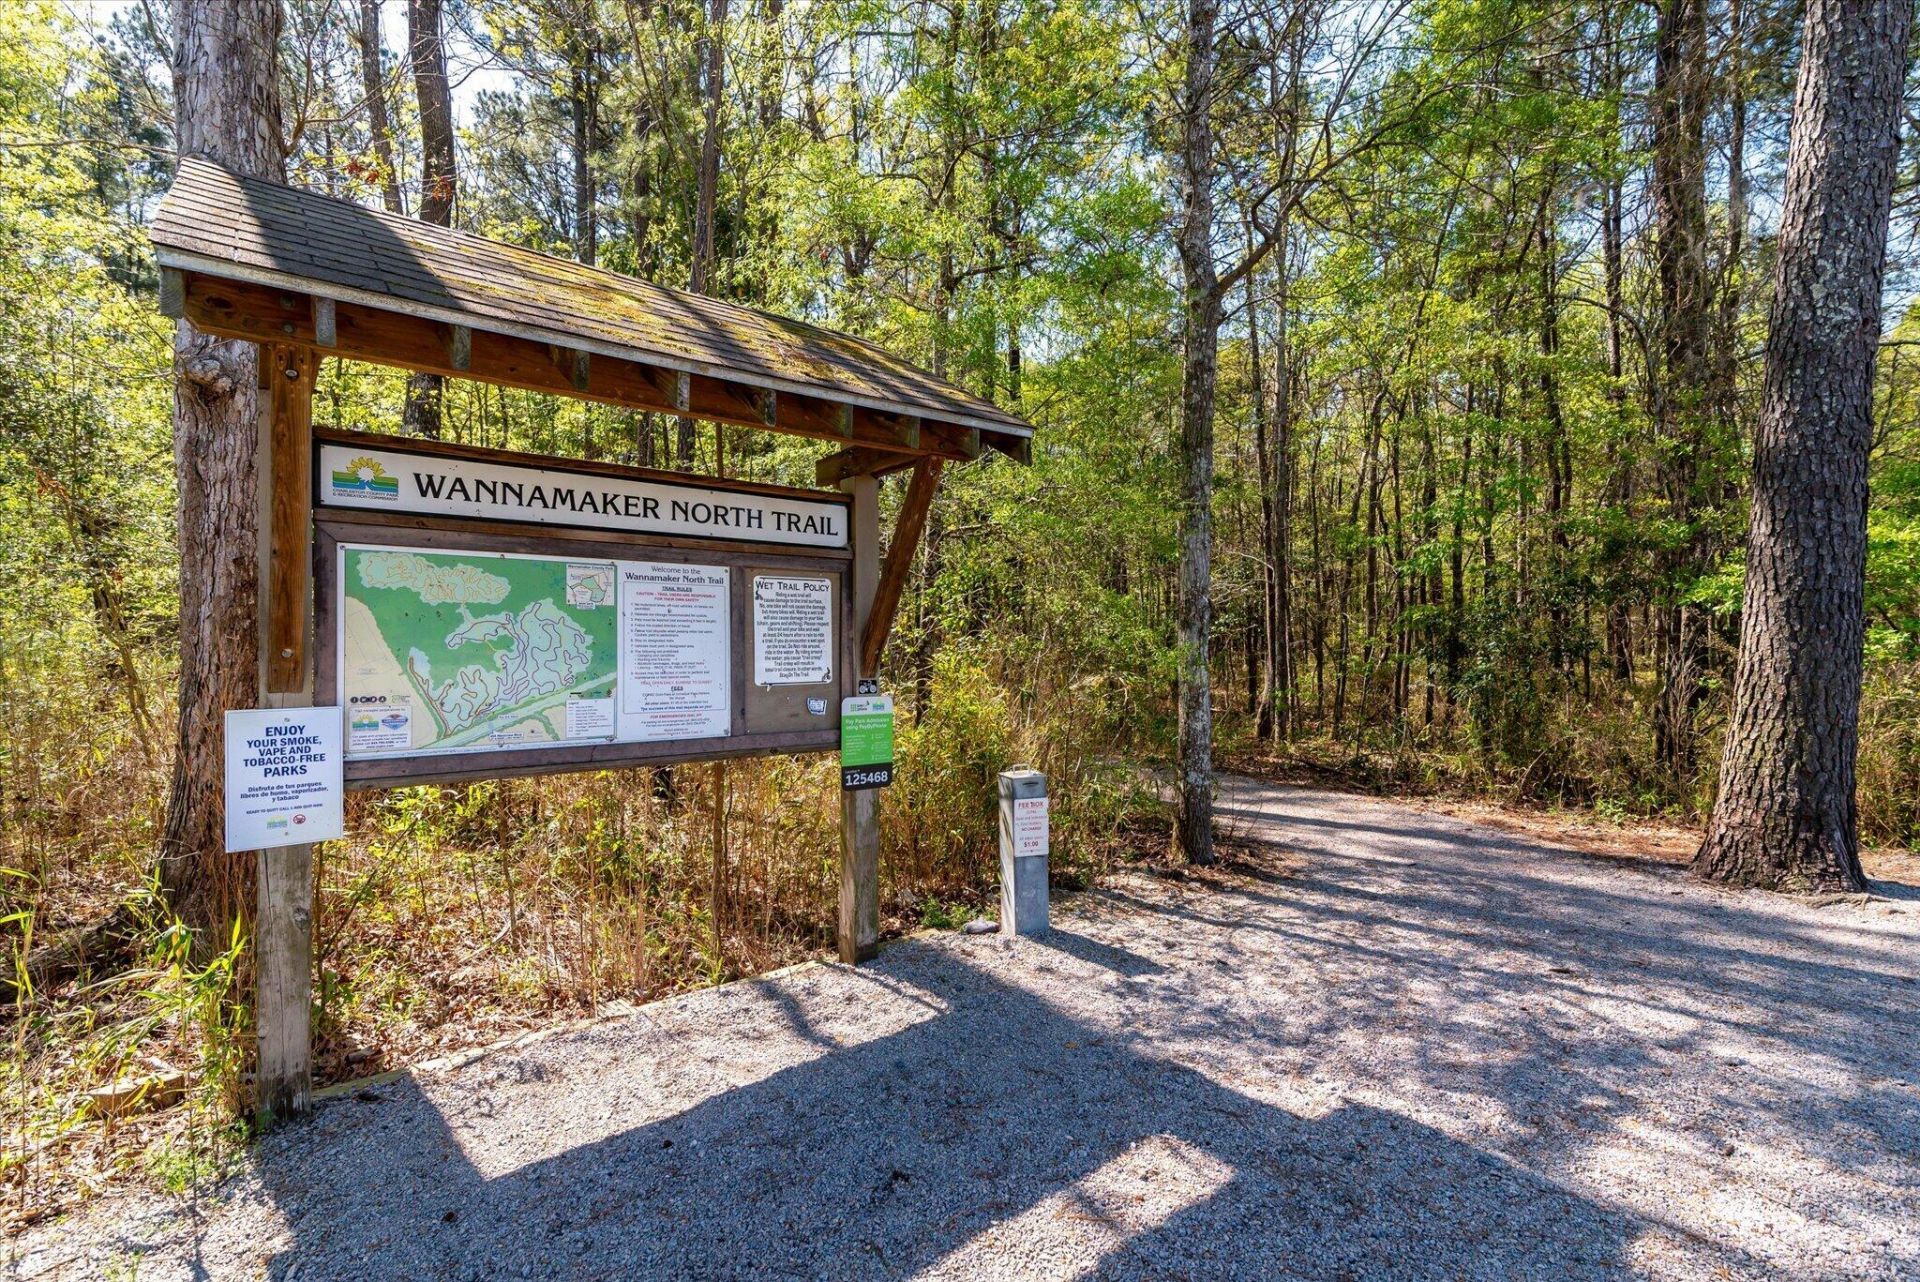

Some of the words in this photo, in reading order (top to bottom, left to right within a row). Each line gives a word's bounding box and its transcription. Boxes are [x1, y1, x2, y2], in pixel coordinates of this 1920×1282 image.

[413, 473, 660, 520] WANNAMAKER
[671, 500, 763, 528] NORTH
[772, 511, 838, 536] TRAIL
[651, 566, 681, 574] Welcome
[625, 572, 679, 582] Wannamaker
[683, 575, 705, 583] North
[707, 576, 723, 584] Trail
[266, 725, 305, 737] ENJOY
[247, 739, 277, 748] YOUR
[280, 736, 322, 746] SMOKE,
[259, 747, 286, 757] VAPE
[289, 746, 311, 755] AND
[244, 753, 326, 767] TOBACCO-FREE
[264, 765, 307, 777] PARKS
[846, 770, 888, 786] 125468
[291, 786, 328, 794] vaporizador,
